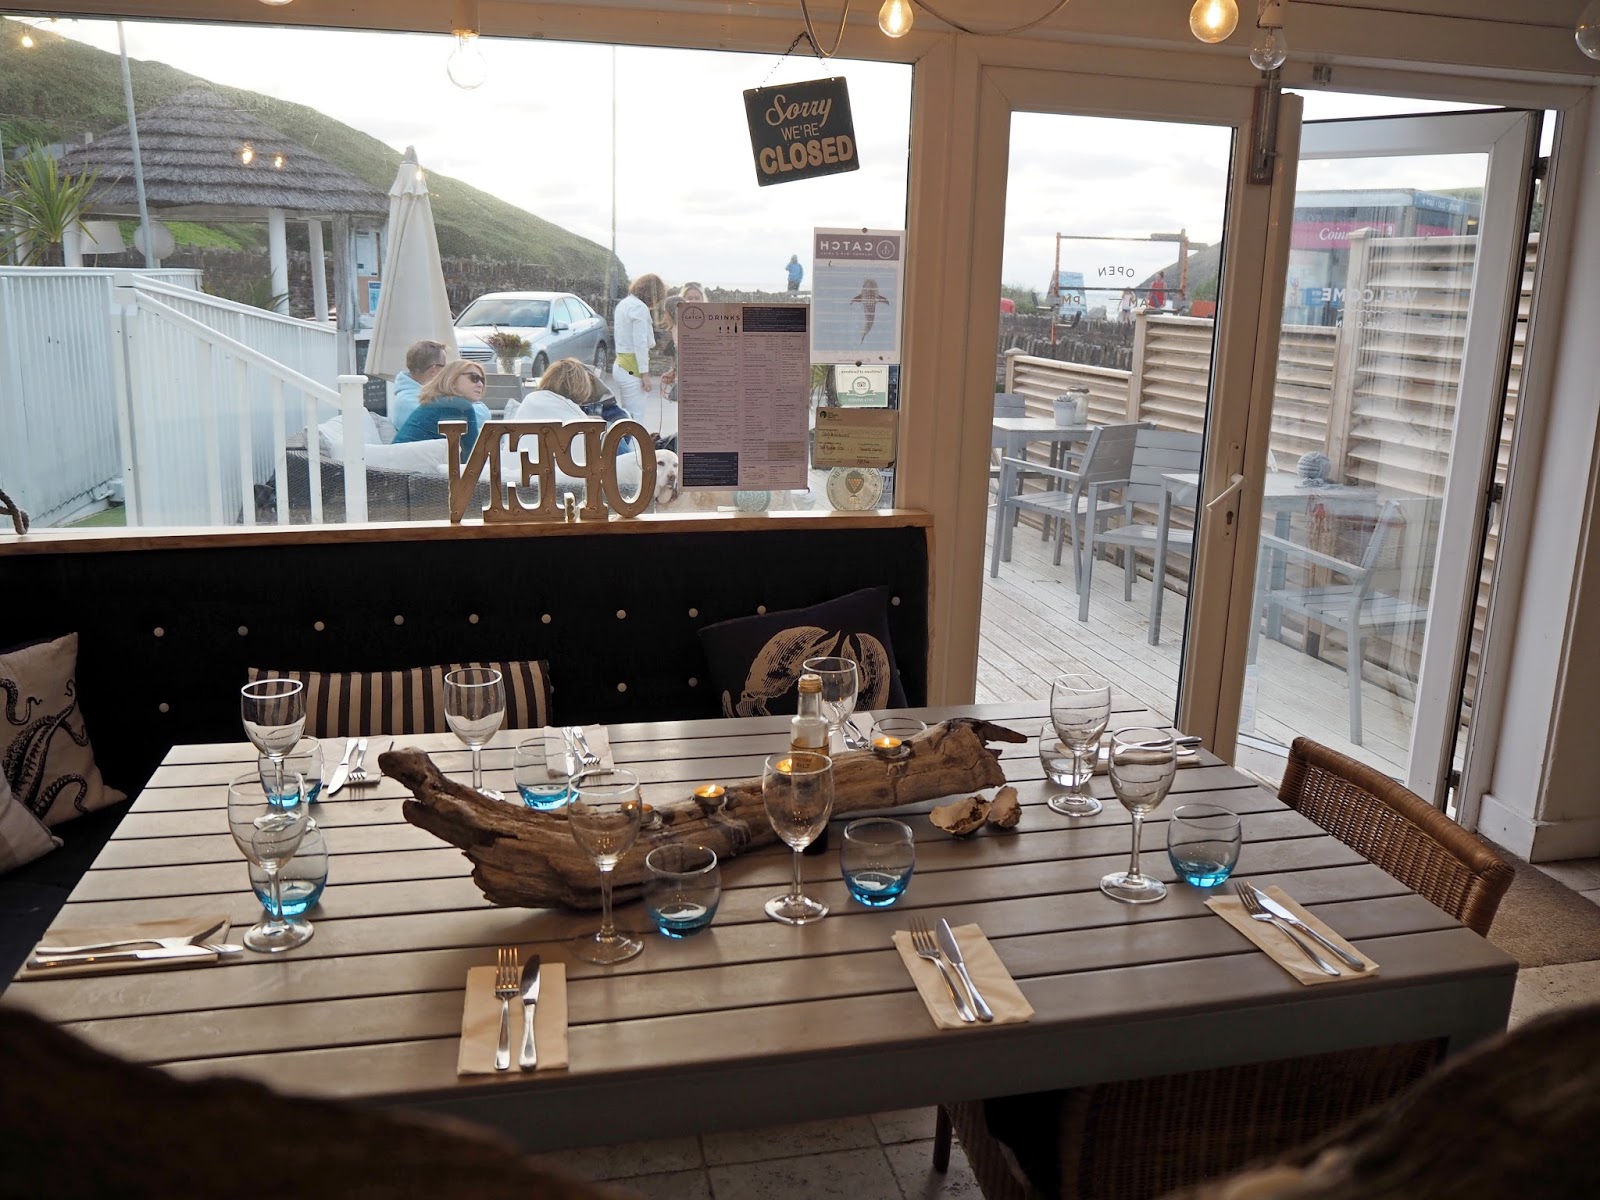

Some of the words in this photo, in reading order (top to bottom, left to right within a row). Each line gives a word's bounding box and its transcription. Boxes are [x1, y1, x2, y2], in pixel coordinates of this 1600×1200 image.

[765, 94, 832, 128] Sorry
[781, 122, 820, 141] WE'RE
[759, 135, 854, 175] CLOSED
